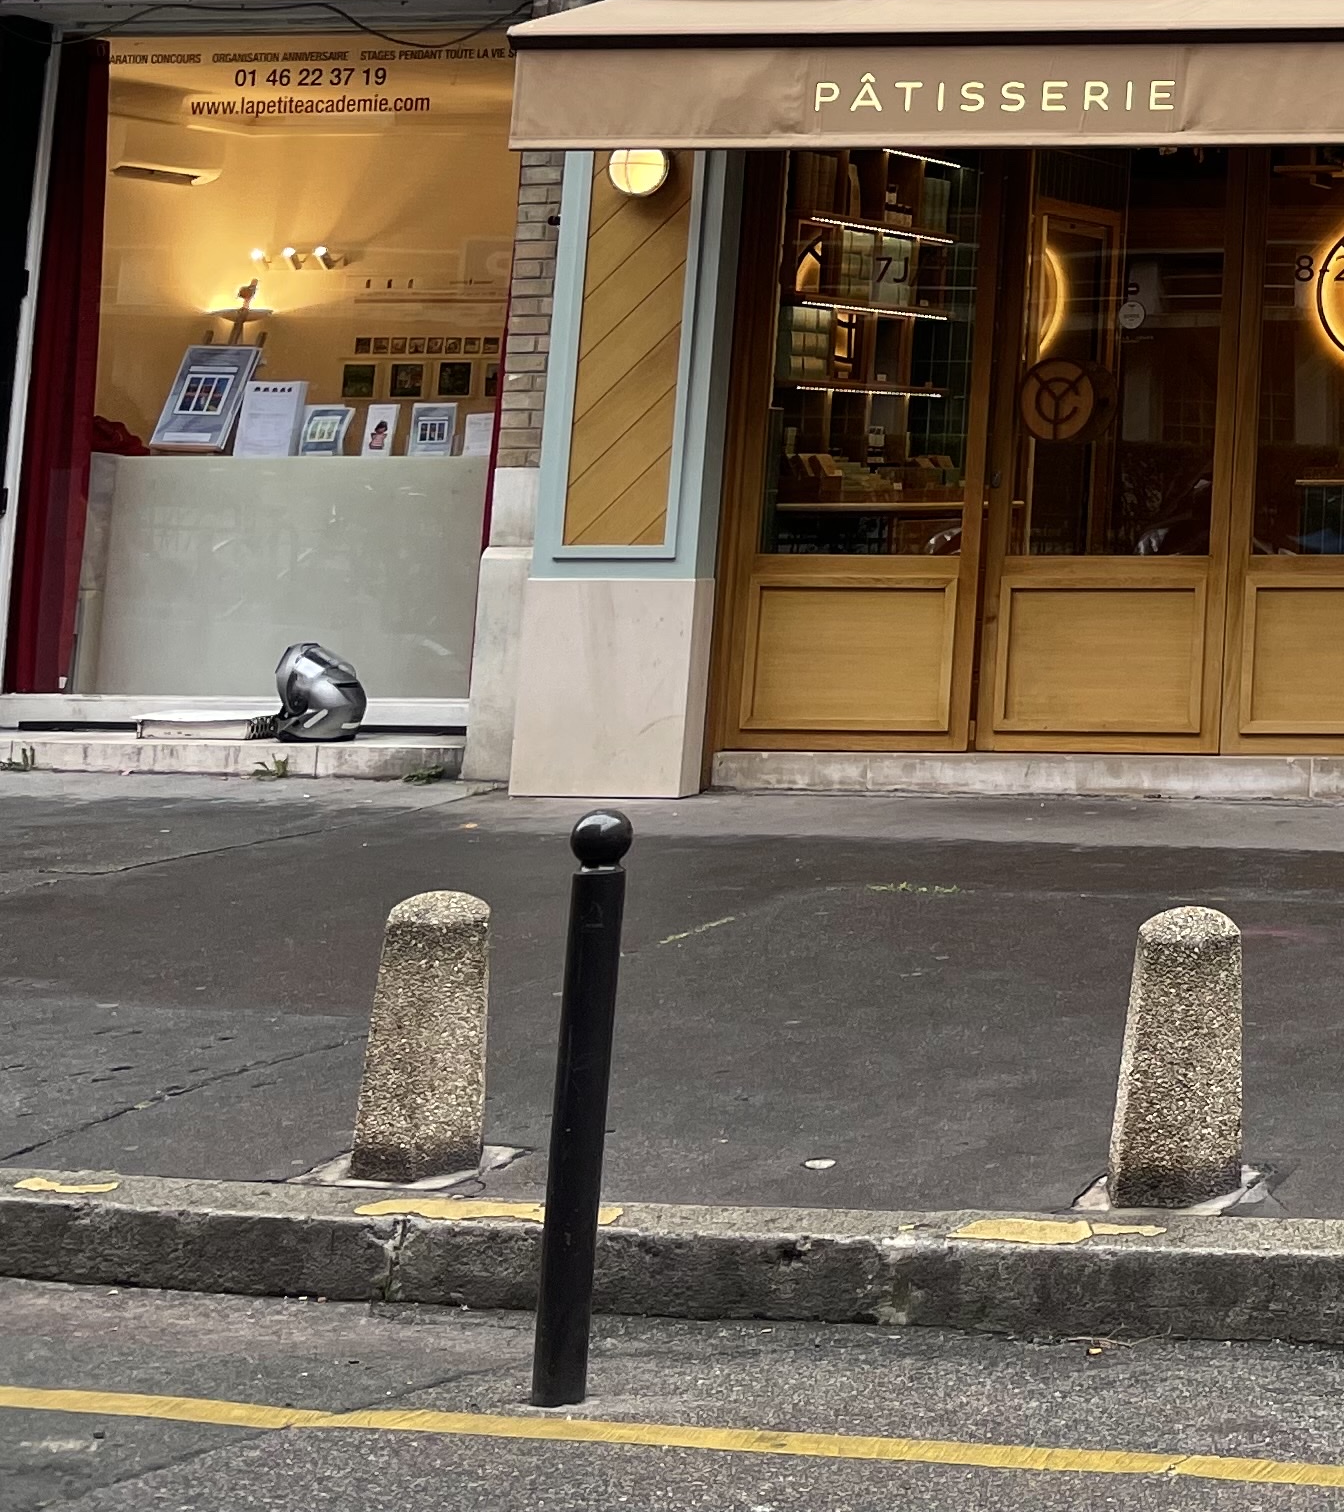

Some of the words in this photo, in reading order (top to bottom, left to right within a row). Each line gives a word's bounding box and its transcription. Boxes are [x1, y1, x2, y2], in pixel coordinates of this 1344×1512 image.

[151, 53, 202, 64] CONCOURS
[212, 52, 280, 64] ORGANISATION
[281, 50, 349, 63] ANNIVERSAIRE
[360, 50, 396, 61] STAGES
[398, 49, 442, 61] PENDANT
[445, 48, 474, 60] TOUTE
[477, 48, 489, 59] LA
[234, 68, 257, 87] 01
[265, 68, 291, 87] 46
[297, 68, 324, 87] 22
[329, 67, 356, 86] 37
[362, 67, 387, 86] 19
[813, 72, 1177, 113] PÂTISSERIE
[191, 94, 430, 119] www.lapetiteacademie.com
